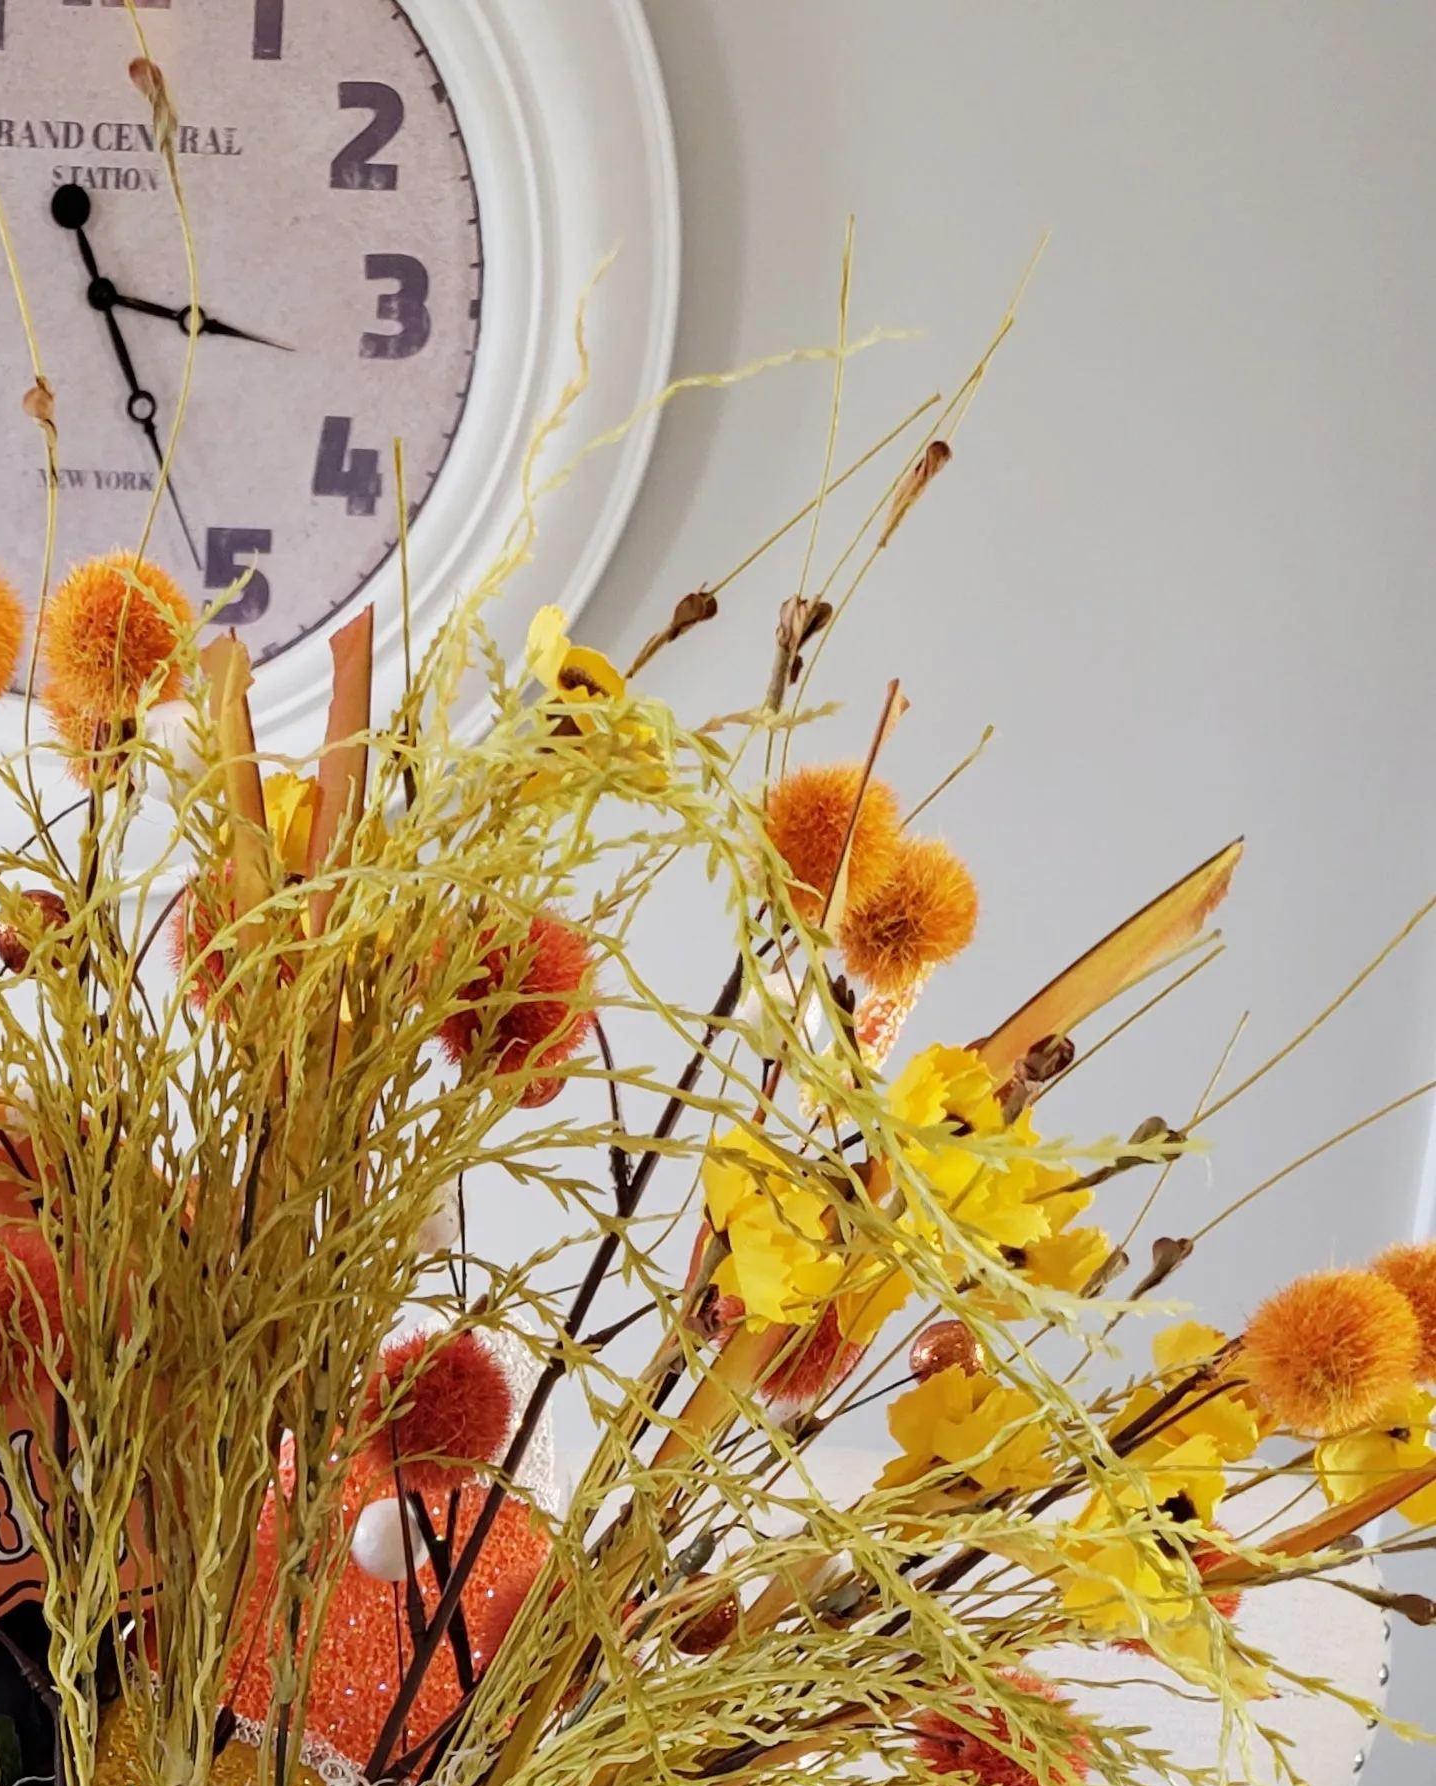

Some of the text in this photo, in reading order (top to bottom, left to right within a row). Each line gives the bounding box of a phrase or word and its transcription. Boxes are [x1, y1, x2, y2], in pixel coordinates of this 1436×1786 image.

[52, 165, 160, 192] STATION
[92, 122, 242, 155] CENRAL
[330, 81, 404, 190] 2
[359, 254, 431, 359] 3
[92, 470, 154, 491] YORK
[313, 416, 382, 516] 4
[203, 527, 272, 625] 5
